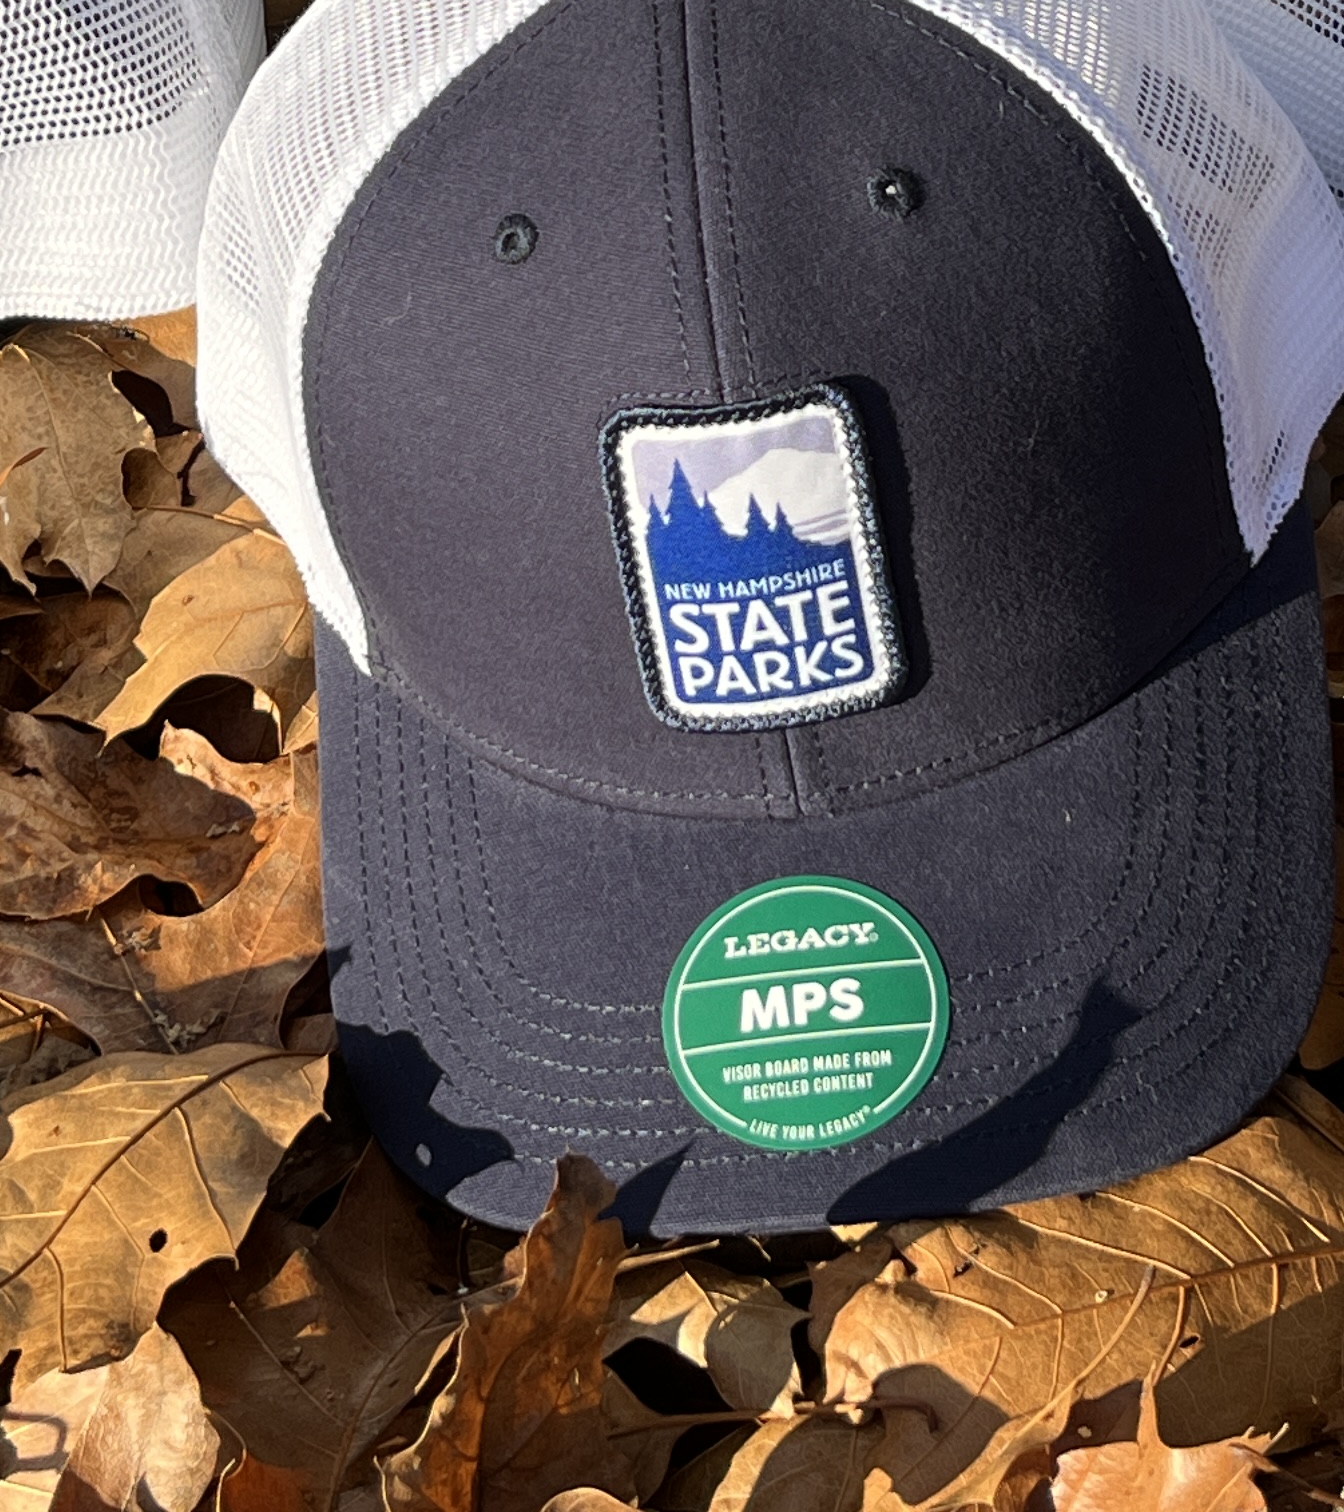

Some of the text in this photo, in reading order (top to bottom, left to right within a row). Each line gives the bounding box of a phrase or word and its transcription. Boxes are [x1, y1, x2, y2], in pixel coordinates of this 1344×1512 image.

[663, 558, 846, 600] NEW HAMPSHIRE
[668, 580, 855, 656] STATE
[679, 635, 864, 697] PARKS
[740, 977, 864, 1033] MPS
[722, 1049, 892, 1084] VISOR BOARD MADE FROM
[743, 1072, 873, 1103] RECYCLED CONTENT
[749, 1119, 779, 1138] LIVE
[782, 1124, 815, 1140] YOUR
